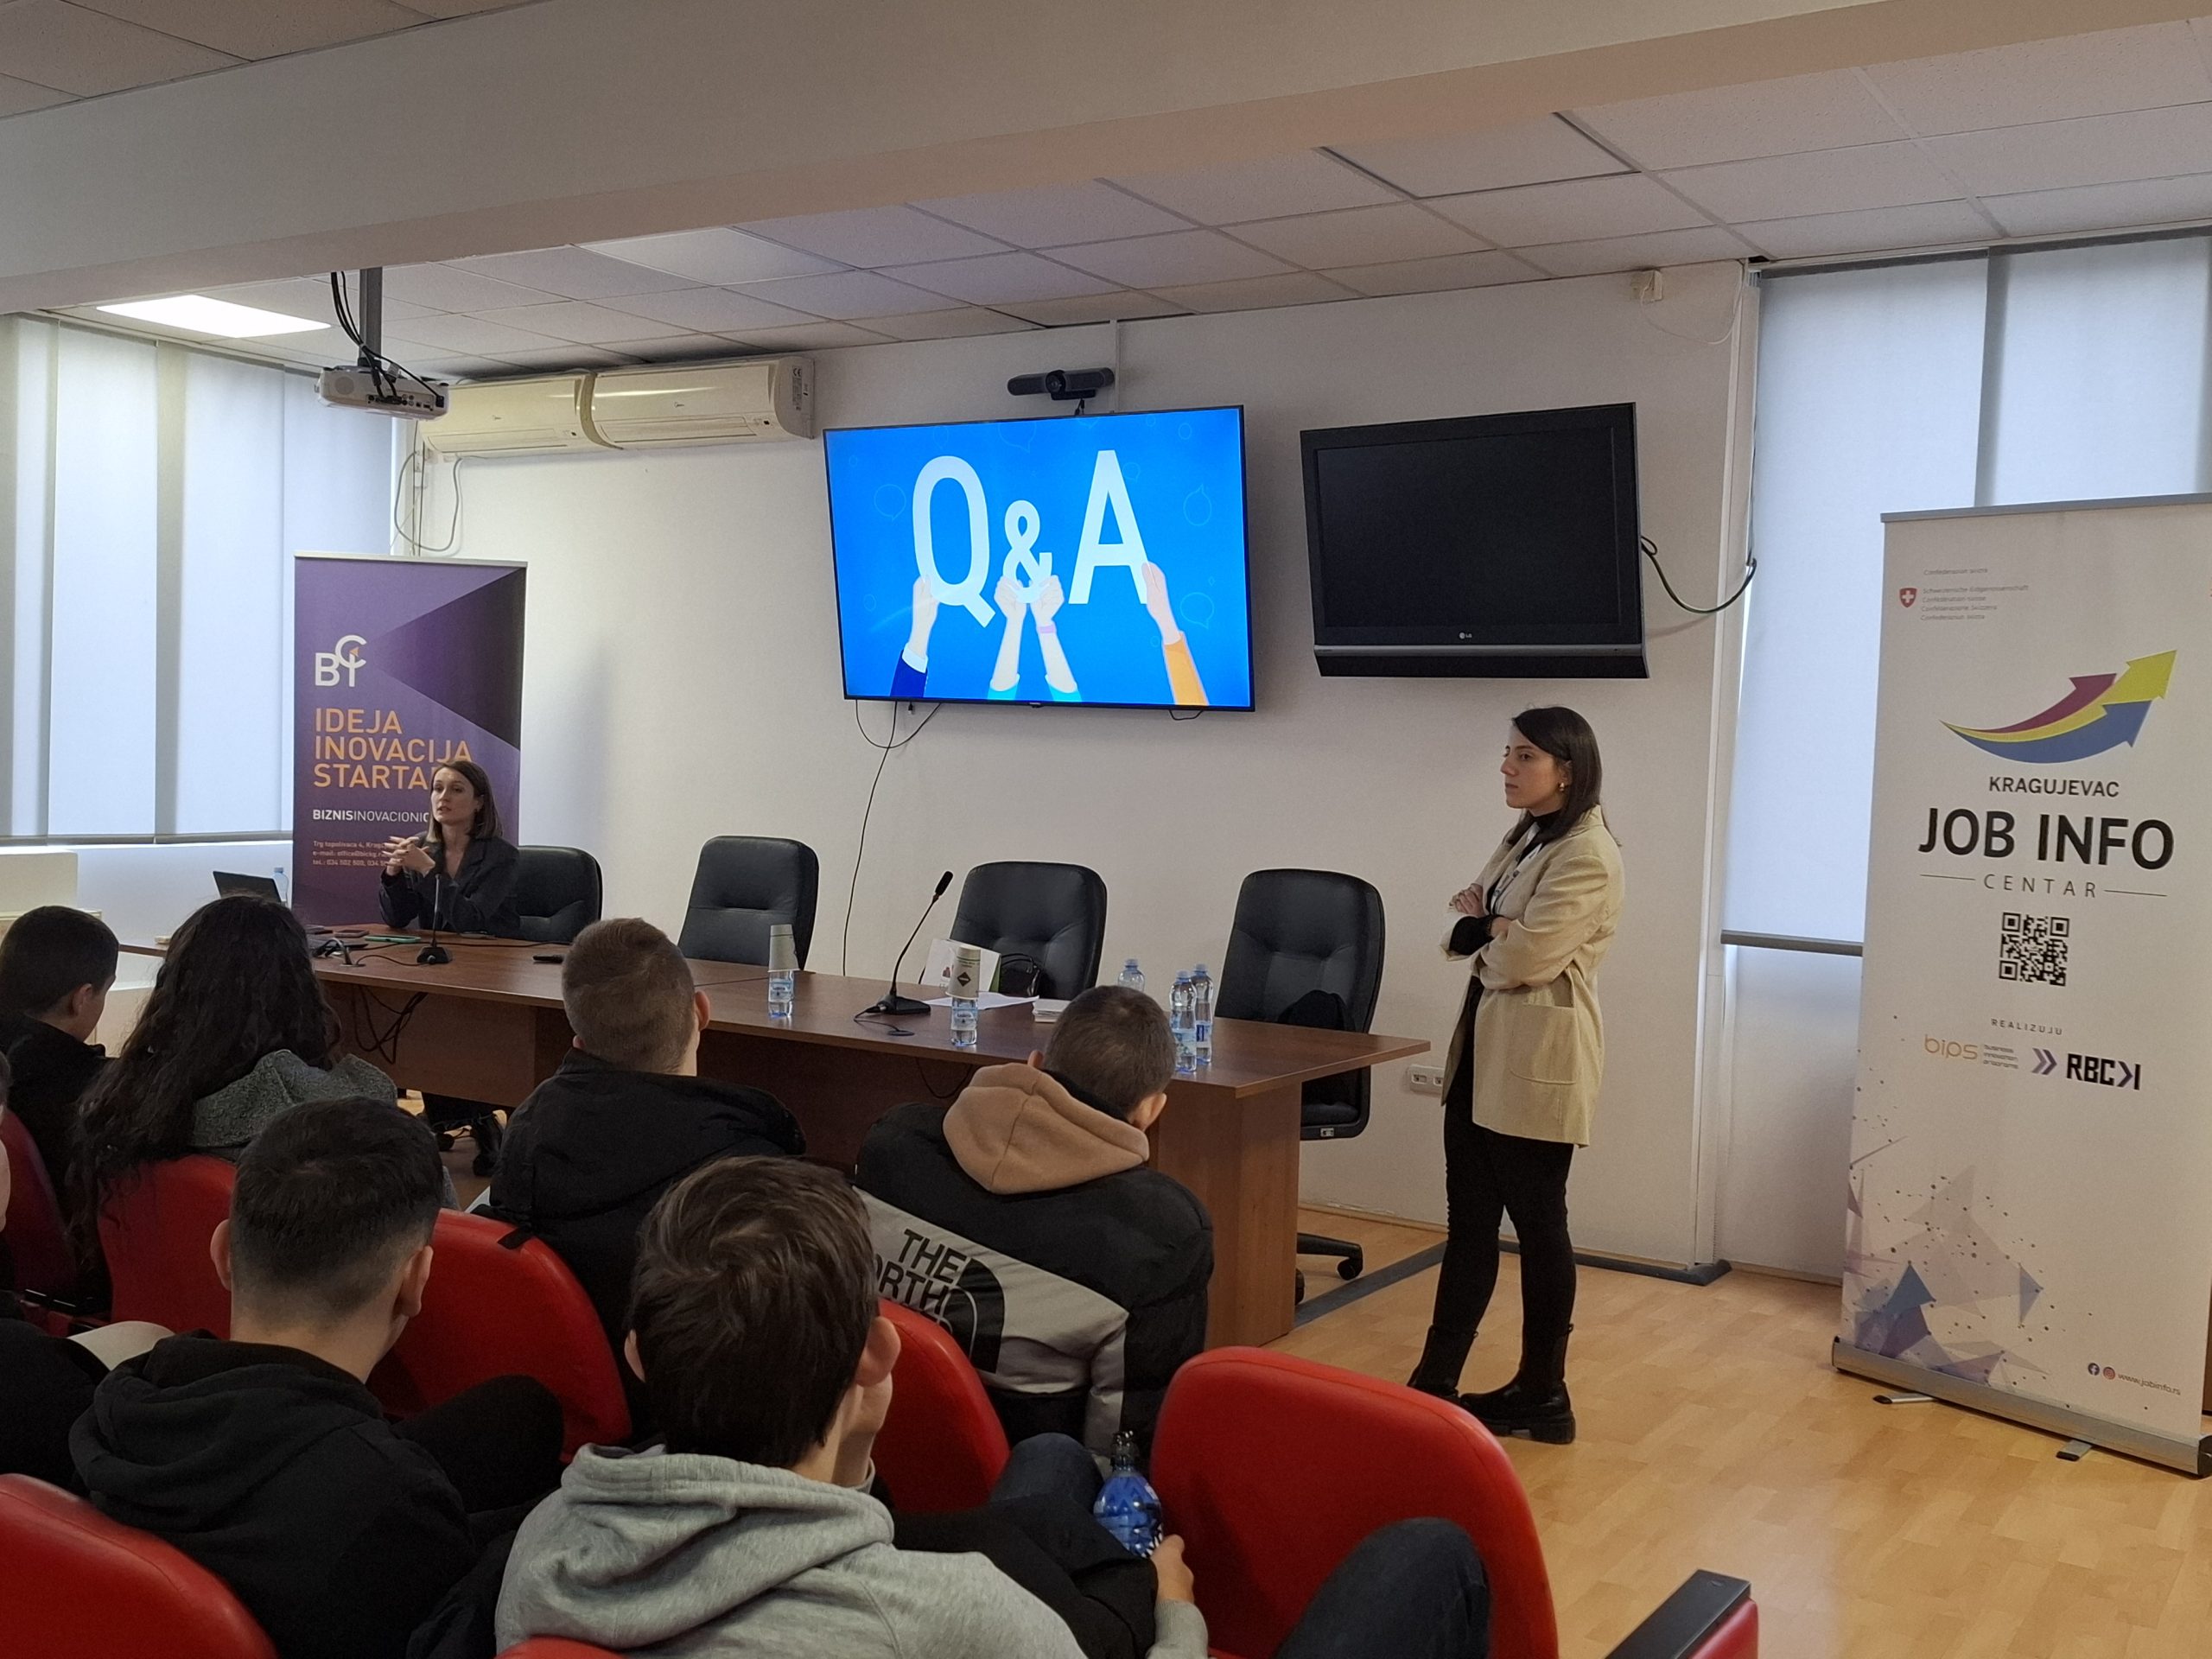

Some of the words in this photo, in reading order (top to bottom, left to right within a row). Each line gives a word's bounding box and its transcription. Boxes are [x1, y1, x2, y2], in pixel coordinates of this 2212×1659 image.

[315, 708, 403, 734] IDEJA
[315, 735, 473, 763] INOVACIJA
[314, 763, 436, 790] STARTA
[1989, 776, 2120, 798] KRAGUJEVAC
[1918, 808, 2016, 858] JOB
[2037, 814, 2174, 870] INFO
[1984, 874, 2096, 898] CENTAR
[1991, 1018, 2063, 1035] REALIZUJU
[1924, 1034, 1979, 1060] bips
[899, 1228, 968, 1284] THE
